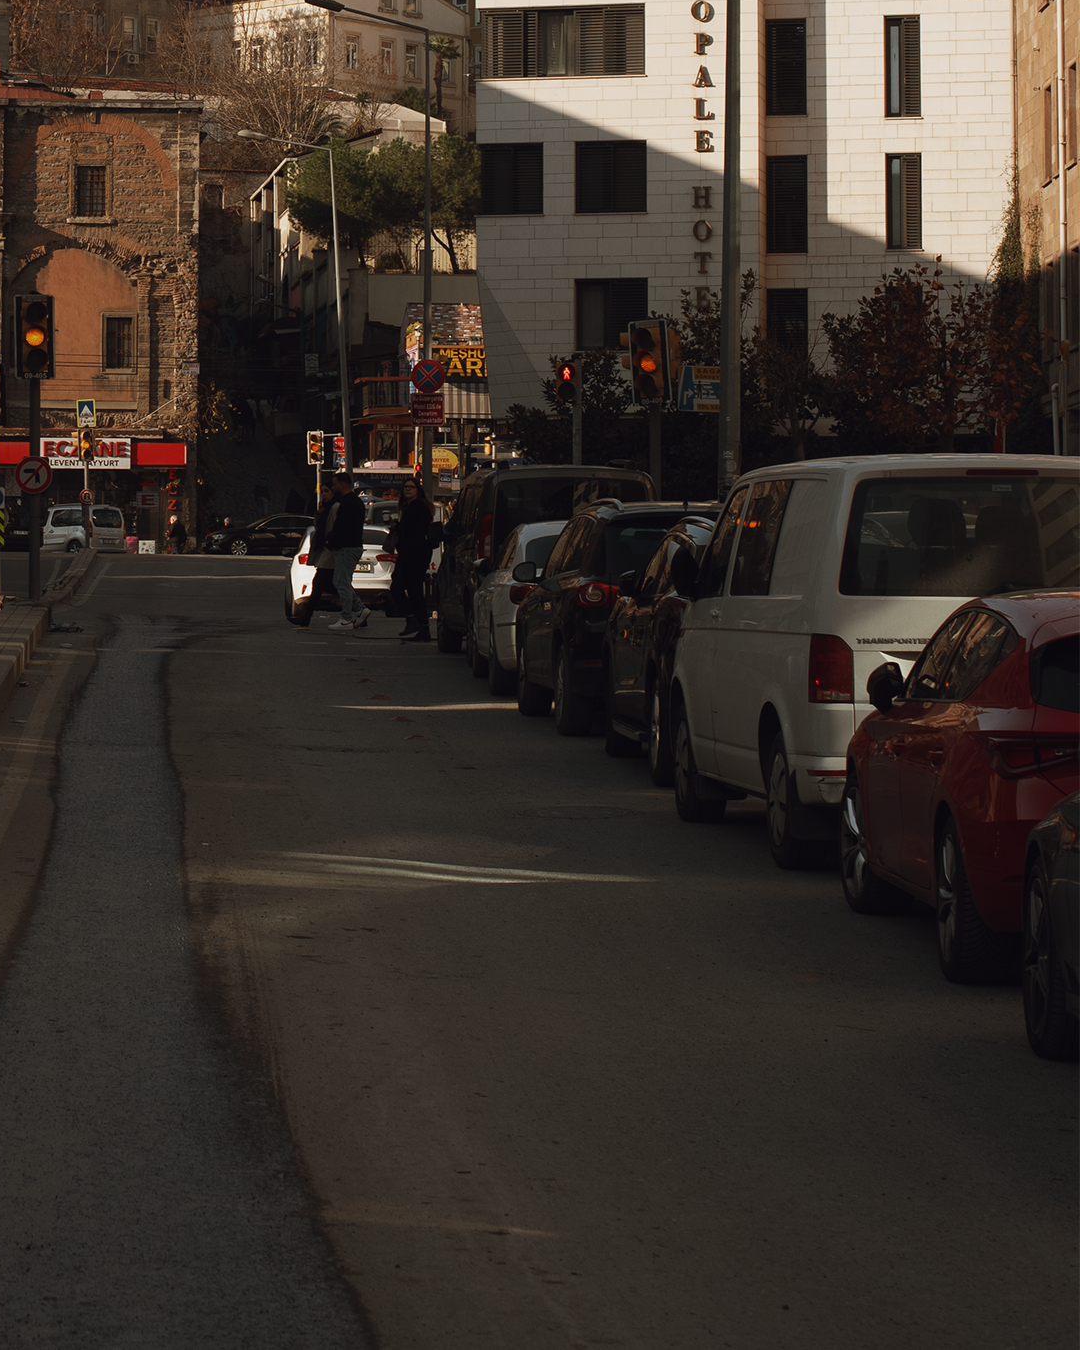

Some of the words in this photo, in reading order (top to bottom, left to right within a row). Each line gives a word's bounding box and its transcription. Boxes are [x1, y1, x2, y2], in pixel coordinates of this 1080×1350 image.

[691, 0, 715, 152] OPALE
[691, 186, 712, 310] HOTE
[440, 348, 486, 360] MEŞHU
[641, 397, 663, 405] 09-405
[43, 441, 127, 457] ECZNE
[50, 459, 80, 467] LEVENT
[142, 494, 155, 506] E
